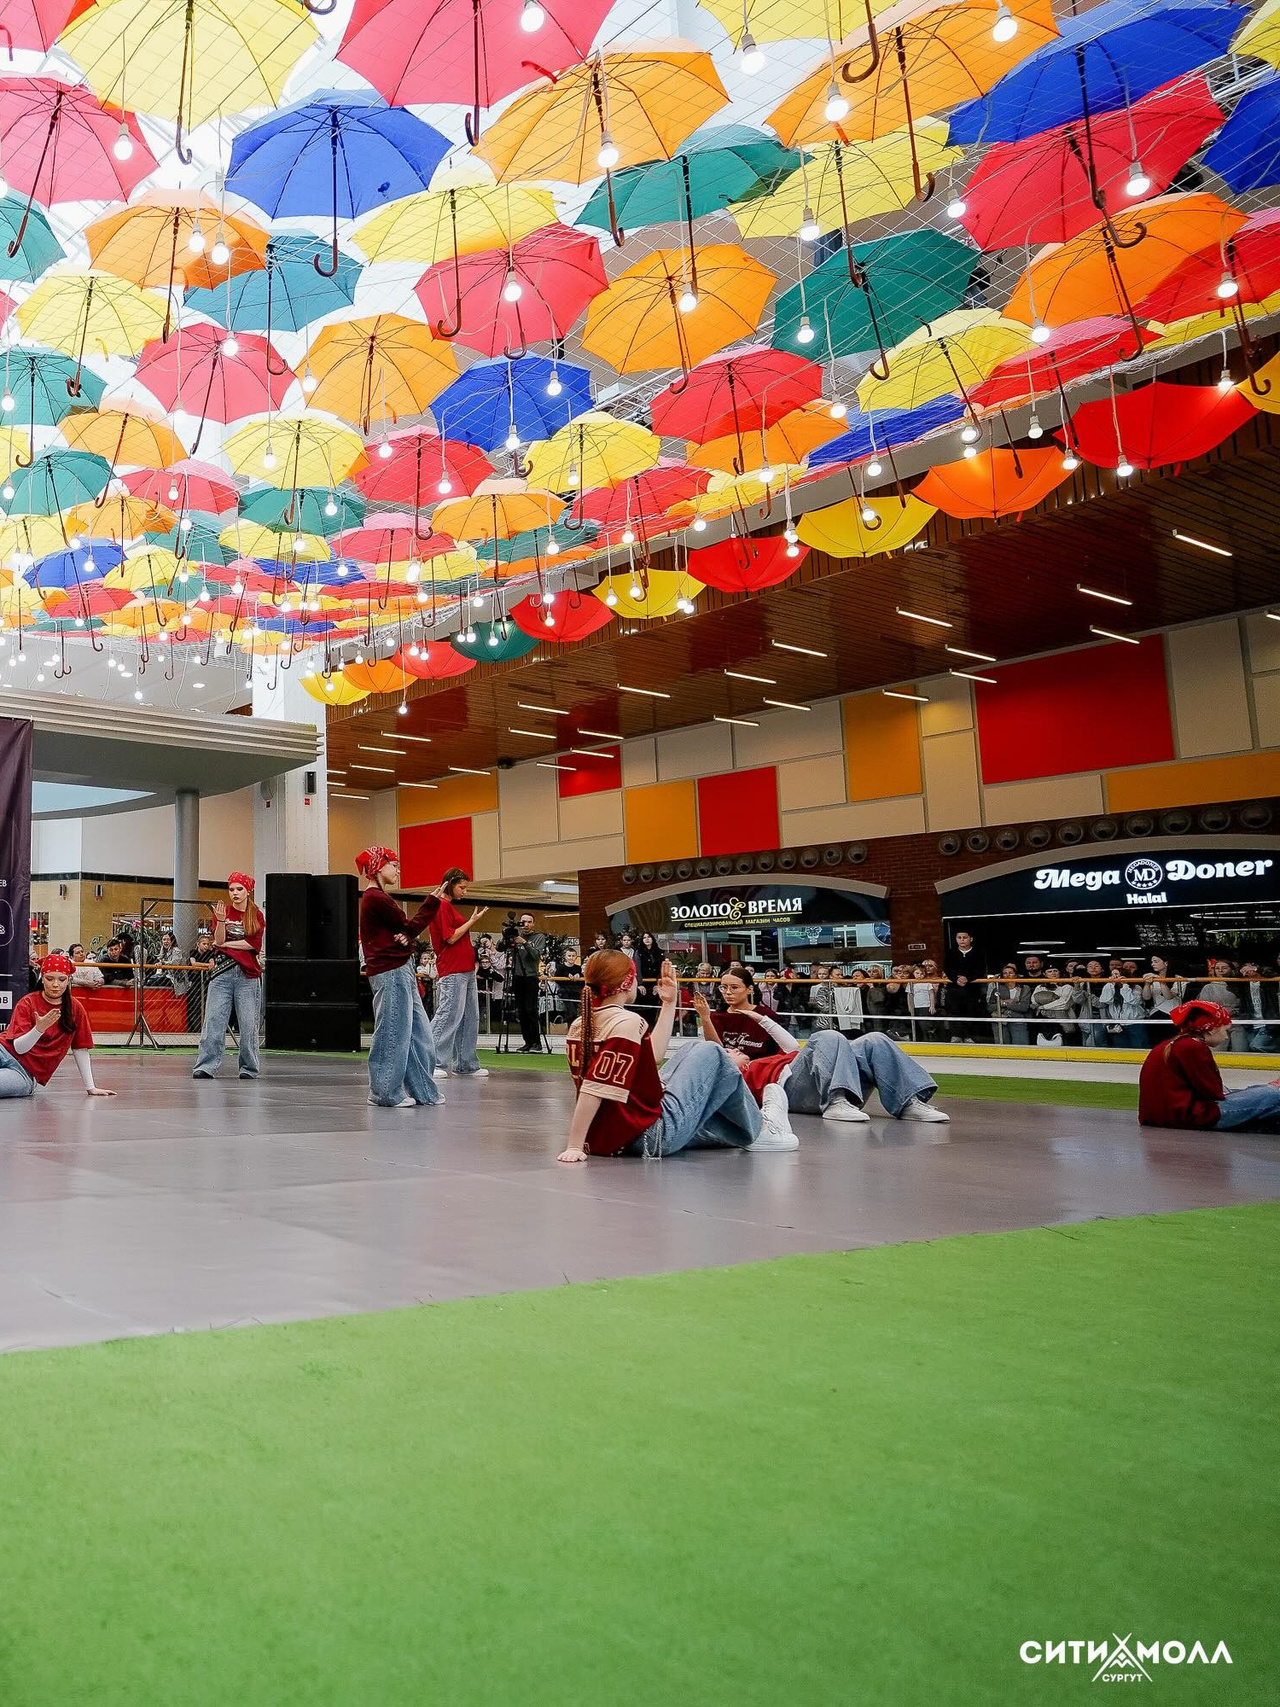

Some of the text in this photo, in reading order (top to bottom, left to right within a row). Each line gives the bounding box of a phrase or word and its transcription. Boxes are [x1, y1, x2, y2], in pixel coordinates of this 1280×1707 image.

[1033, 859, 1273, 891] Mega Doner
[1133, 868, 1156, 882] MD
[1126, 891, 1168, 905] Halal
[670, 902, 731, 919] ЗОЛОТО
[748, 897, 803, 915] ВРЕМЯ
[772, 916, 791, 924] ЧАСОВ
[592, 1049, 634, 1085] 07
